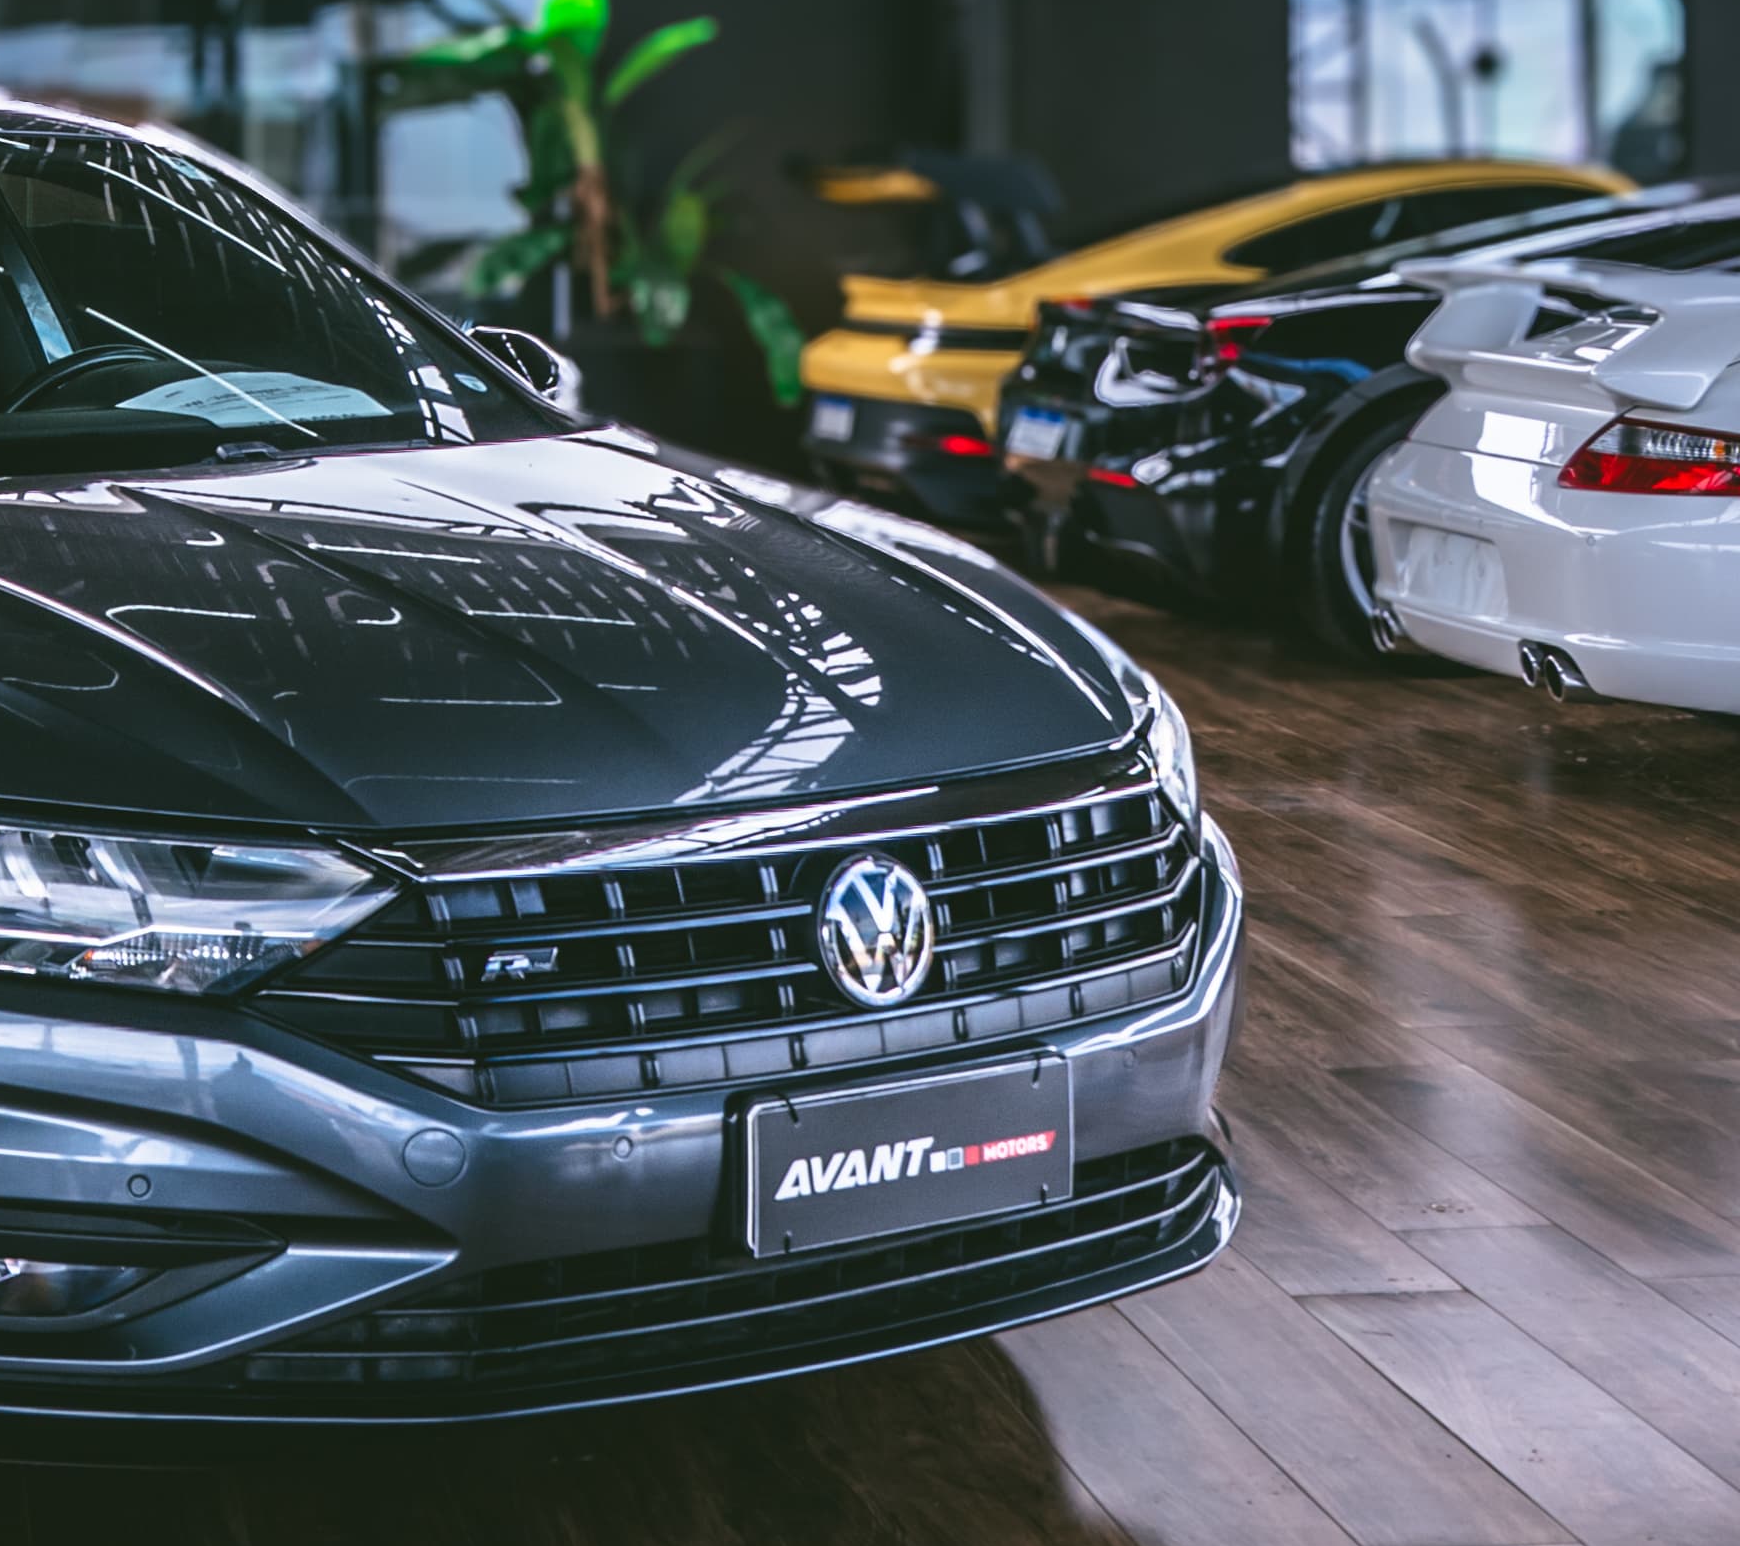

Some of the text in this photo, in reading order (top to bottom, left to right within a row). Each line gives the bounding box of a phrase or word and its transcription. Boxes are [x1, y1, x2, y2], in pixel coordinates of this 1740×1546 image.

[820, 854, 932, 1006] VW
[774, 1133, 1049, 1201] AVANT MOTORS
